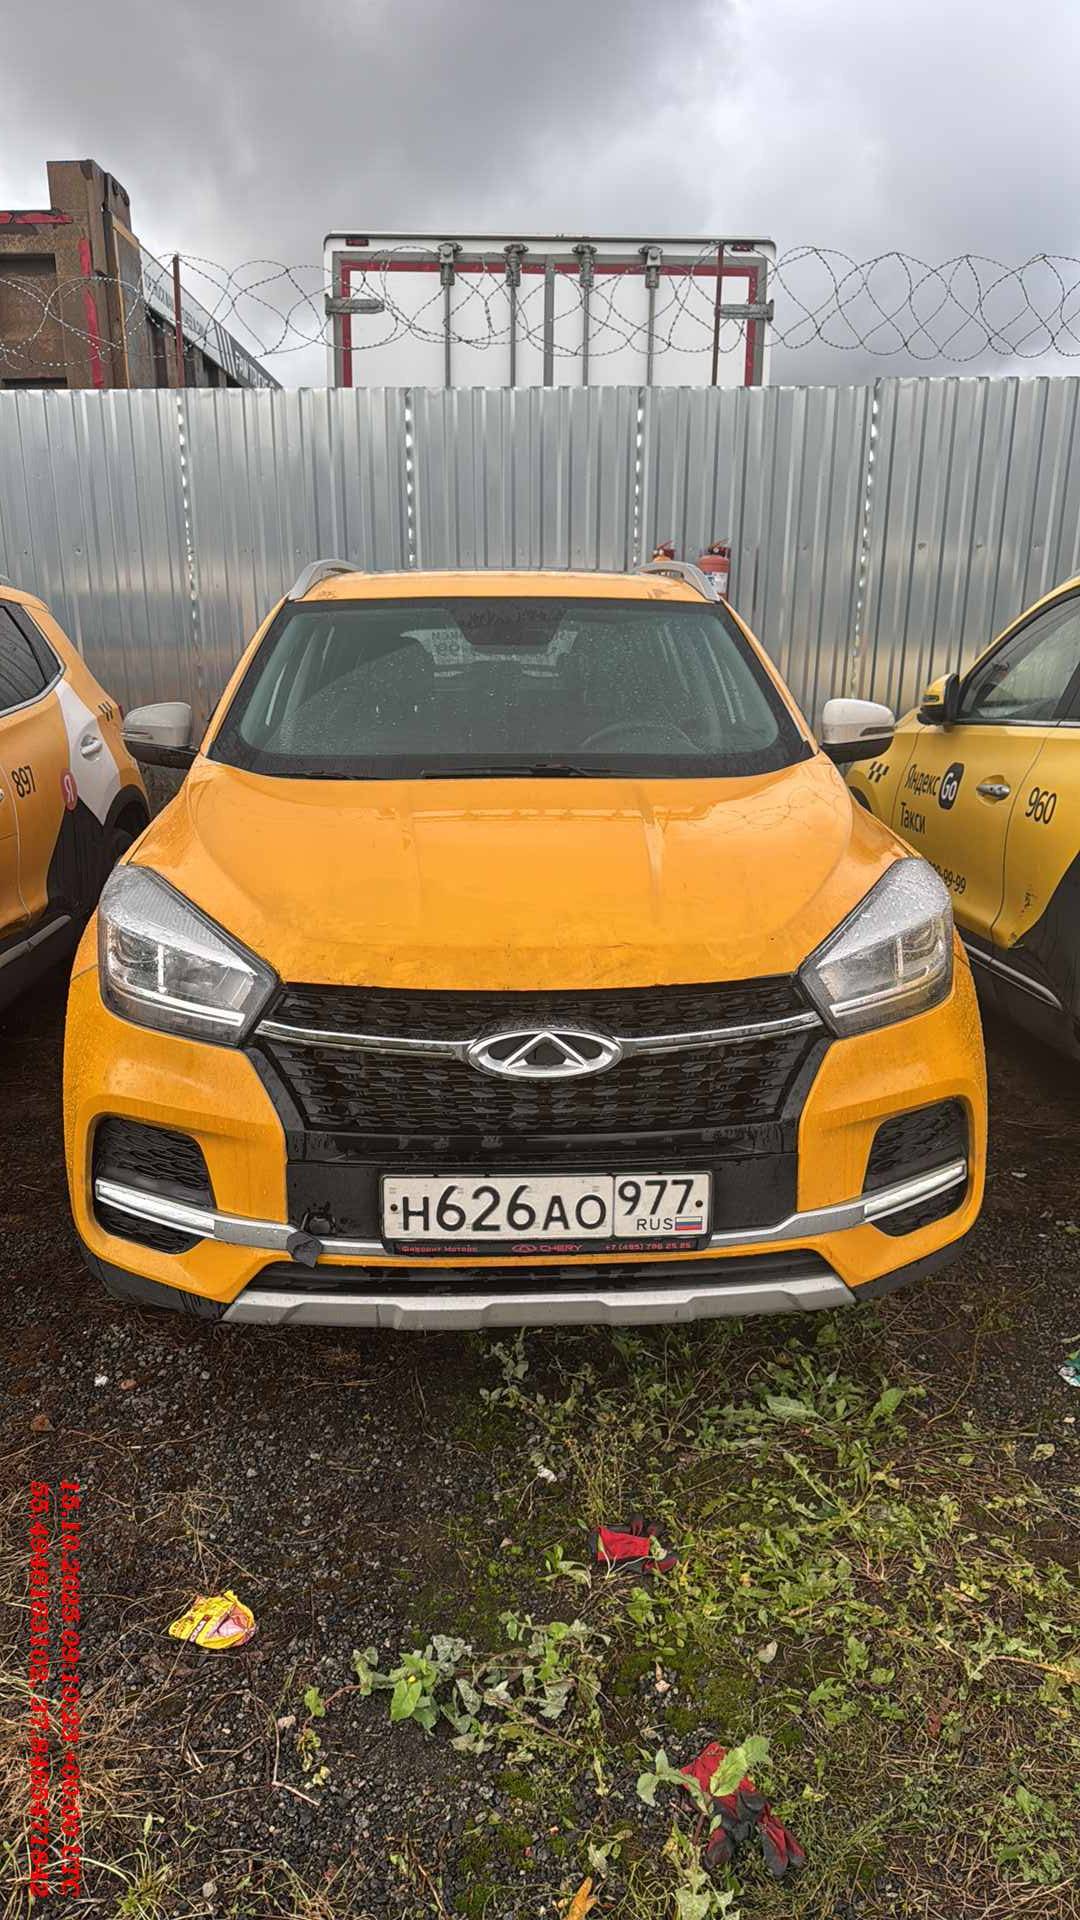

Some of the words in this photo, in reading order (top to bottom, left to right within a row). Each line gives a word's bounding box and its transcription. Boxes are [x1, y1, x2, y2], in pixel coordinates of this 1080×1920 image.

[11, 765, 36, 798] 897
[904, 763, 941, 796] Яндекс
[940, 771, 958, 801] Go
[901, 802, 926, 834] Такси
[1025, 787, 1057, 824] 960
[402, 1185, 607, 1232] Н626АО
[618, 1179, 694, 1216] 977
[636, 1217, 674, 1231] RUS
